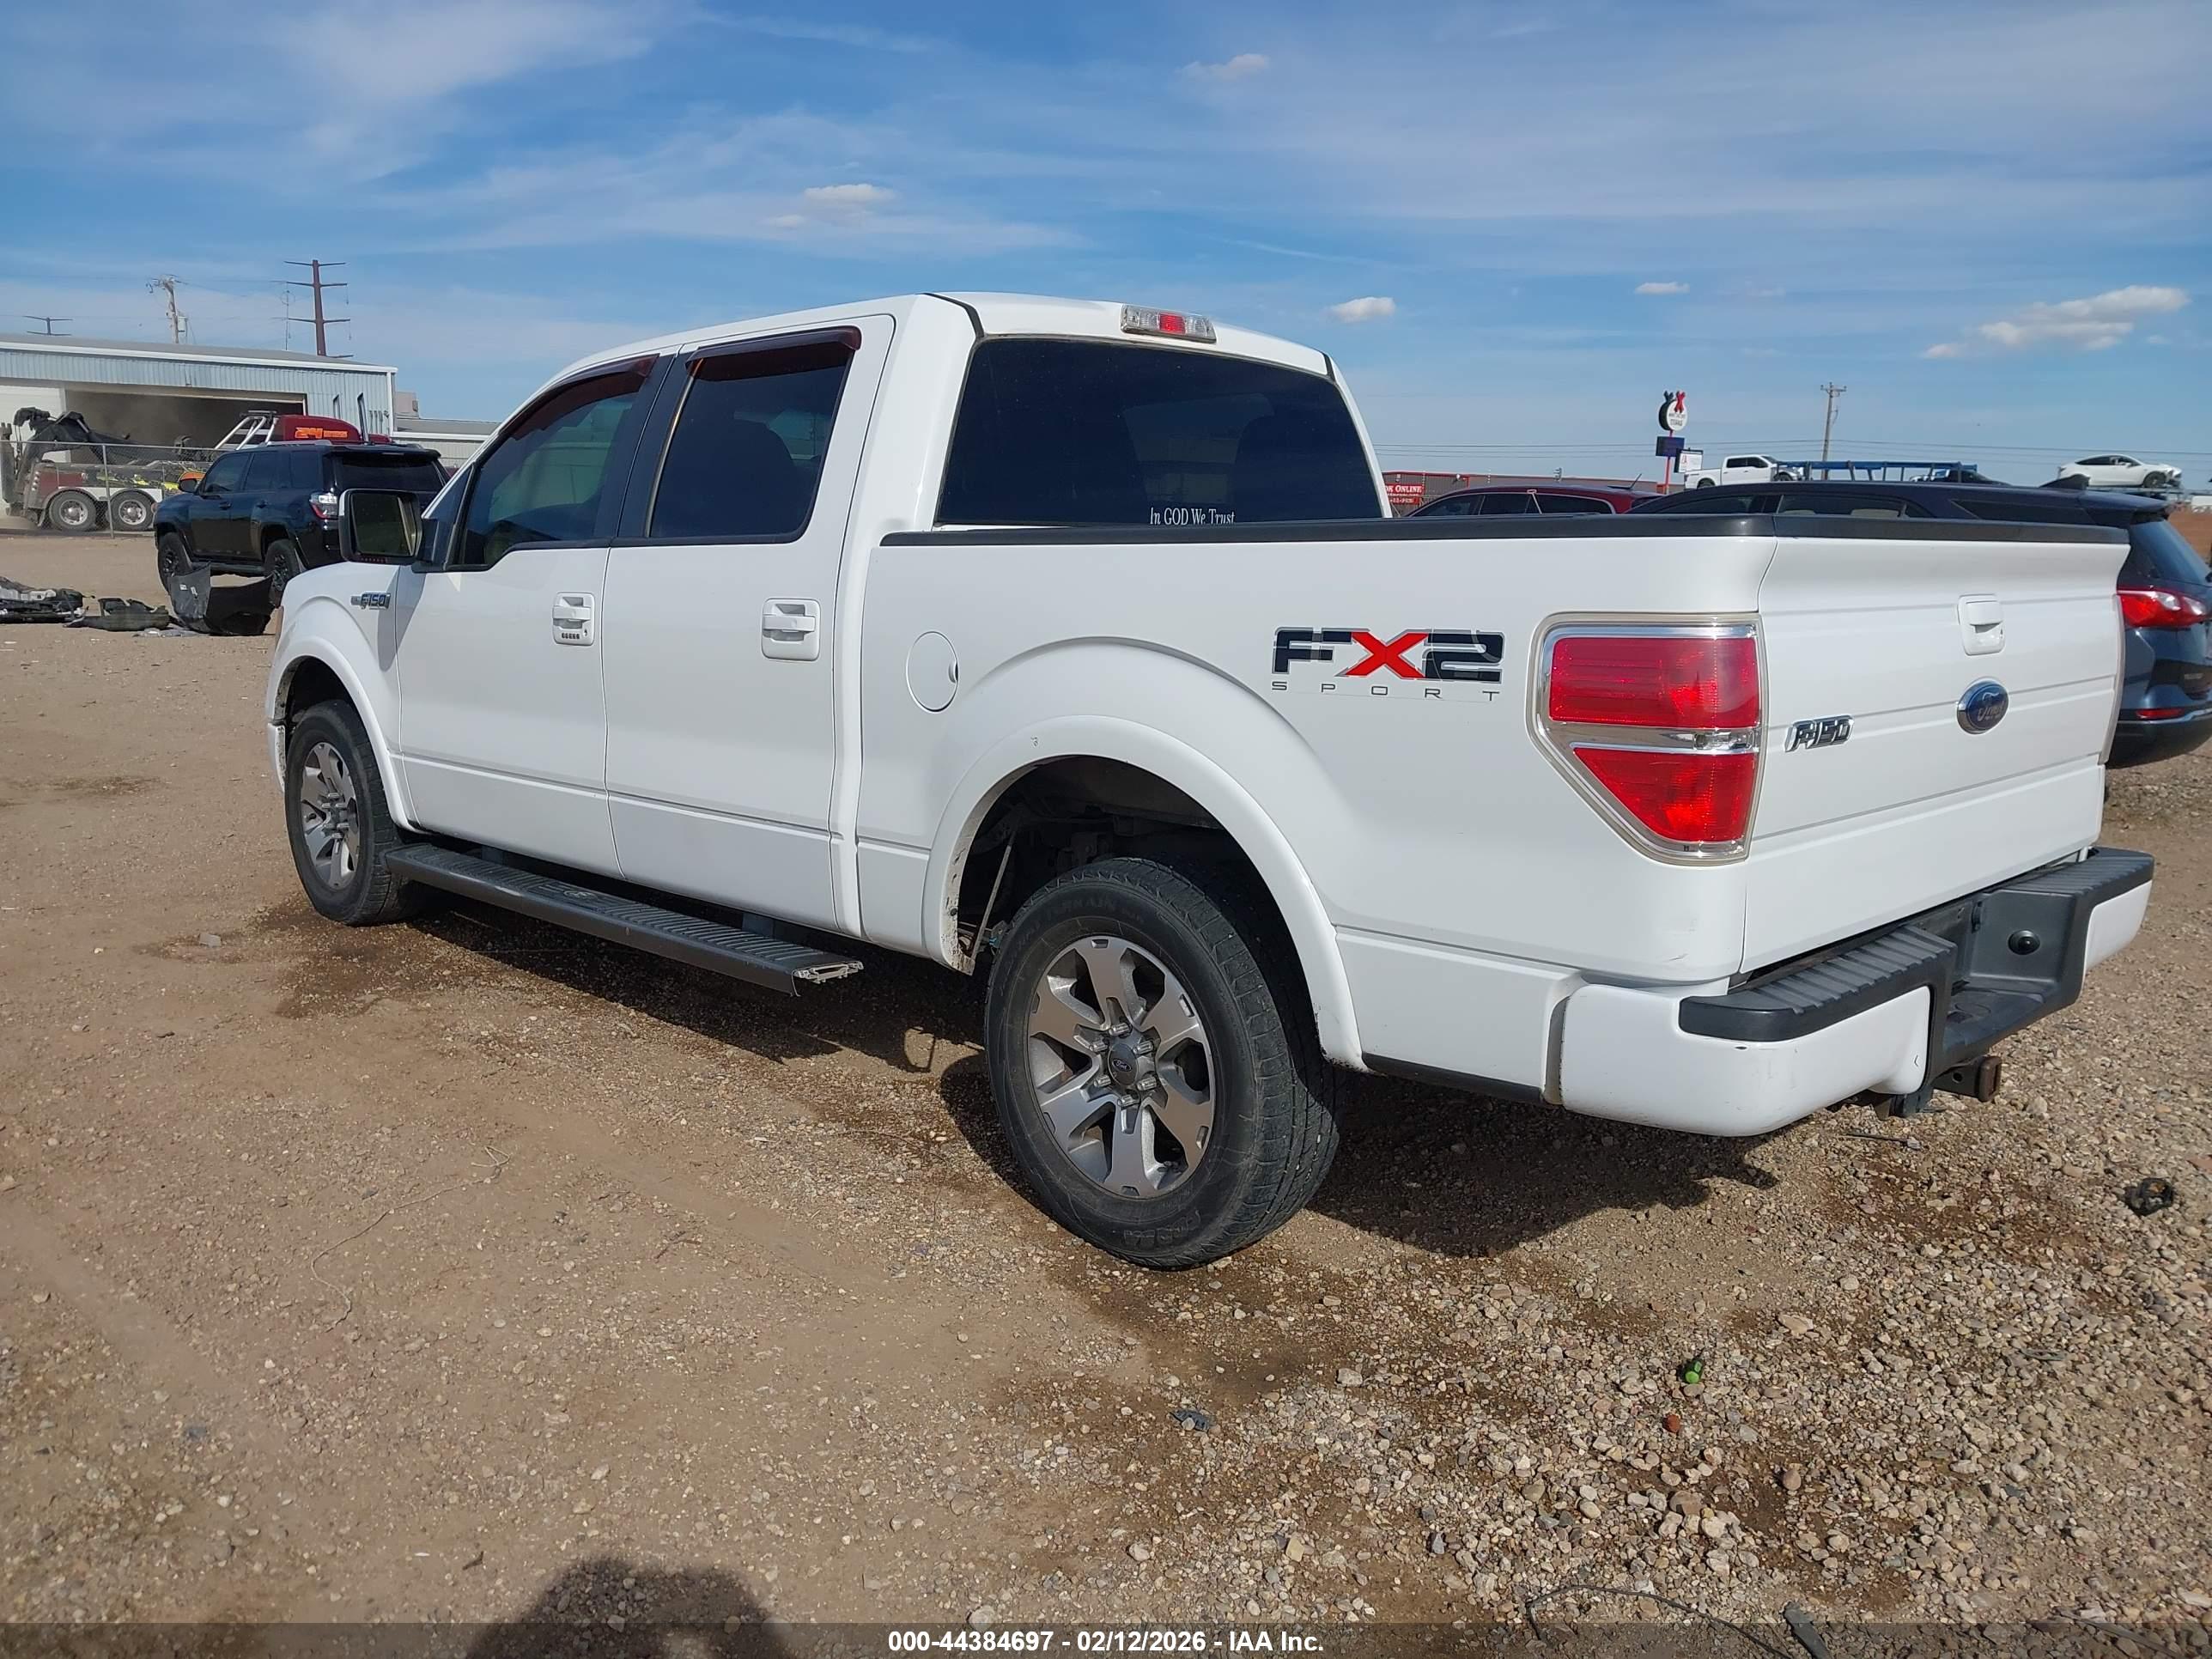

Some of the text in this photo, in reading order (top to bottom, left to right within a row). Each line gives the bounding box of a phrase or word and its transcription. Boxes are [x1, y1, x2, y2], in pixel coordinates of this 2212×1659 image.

[1150, 507, 1236, 526] In GOD We Trust
[1272, 627, 1504, 684] FX2
[1272, 682, 1500, 702] SPORT
